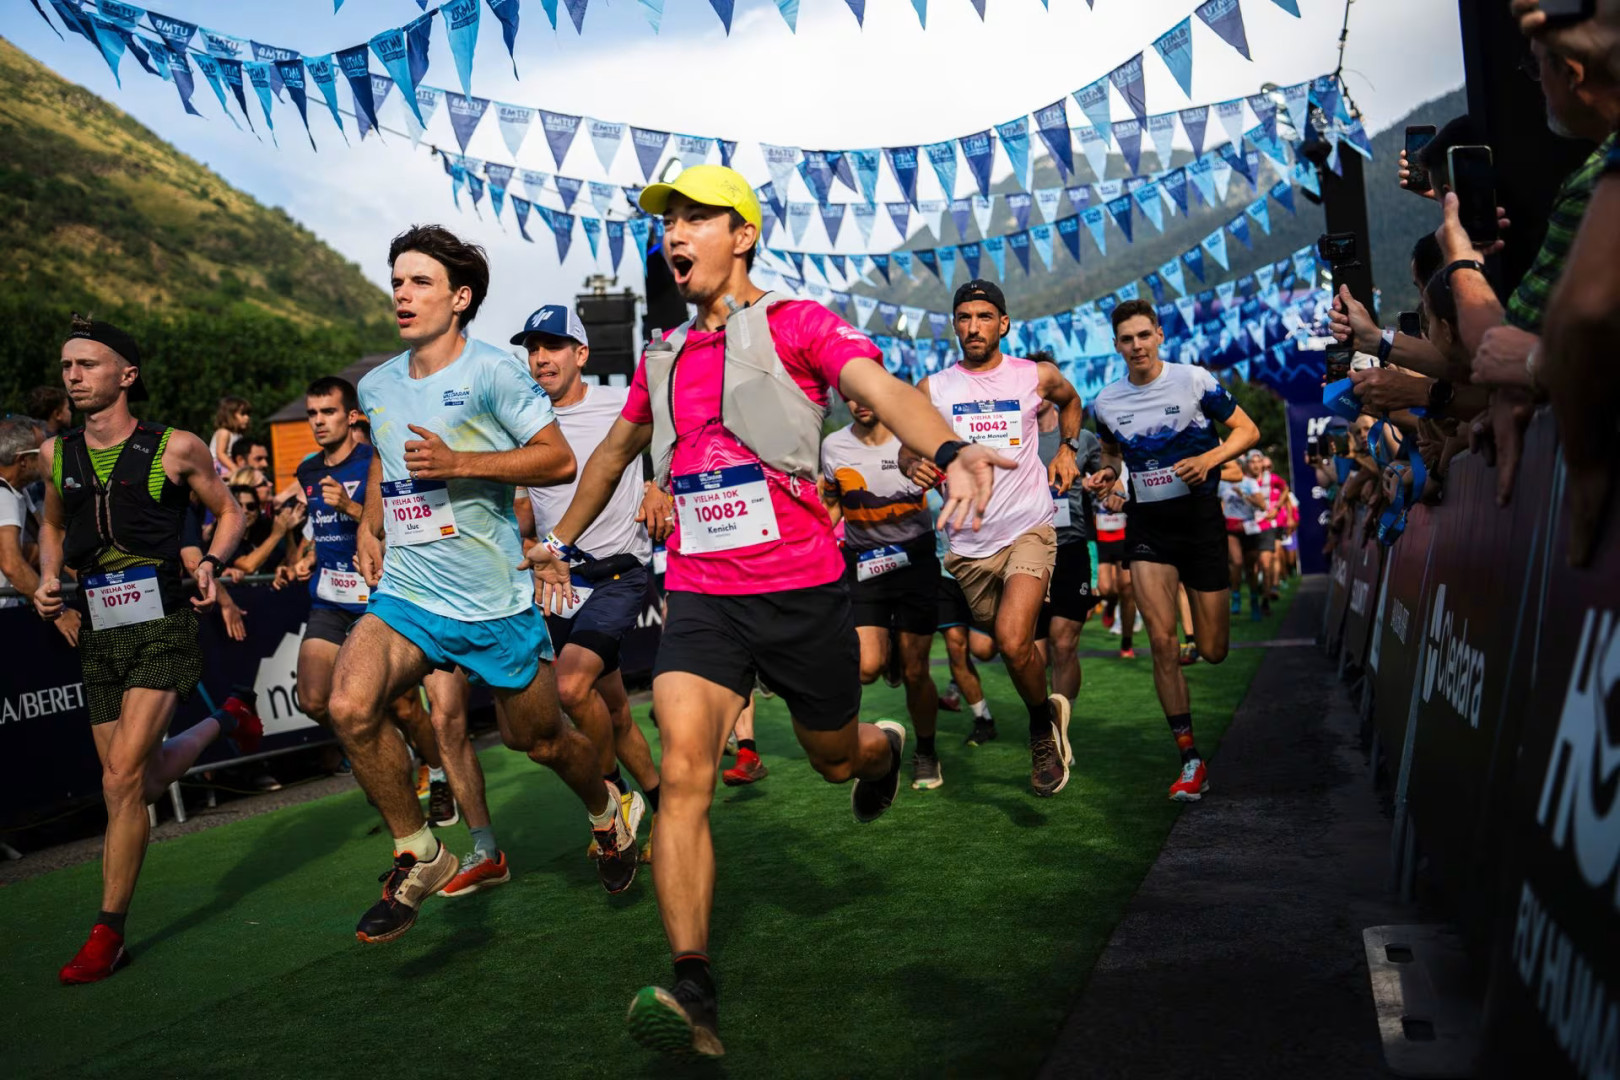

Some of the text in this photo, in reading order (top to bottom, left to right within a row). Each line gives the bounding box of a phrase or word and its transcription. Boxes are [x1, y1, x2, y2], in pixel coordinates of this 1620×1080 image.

[969, 420, 1007, 432] 10042
[1142, 475, 1173, 488] 10228
[391, 495, 426, 507] VIELHA 10K
[693, 489, 739, 504] VIELHA 10K
[393, 504, 432, 522] 10128
[695, 500, 748, 523] 10082
[407, 523, 419, 531] Lluc
[707, 522, 737, 534] Kenichi
[869, 562, 897, 575] 10159
[331, 577, 357, 589] 10039
[100, 587, 122, 595] VIELHA
[102, 591, 141, 608] 10179
[1437, 610, 1485, 730] Cledara
[0, 682, 84, 724] A/BERET
